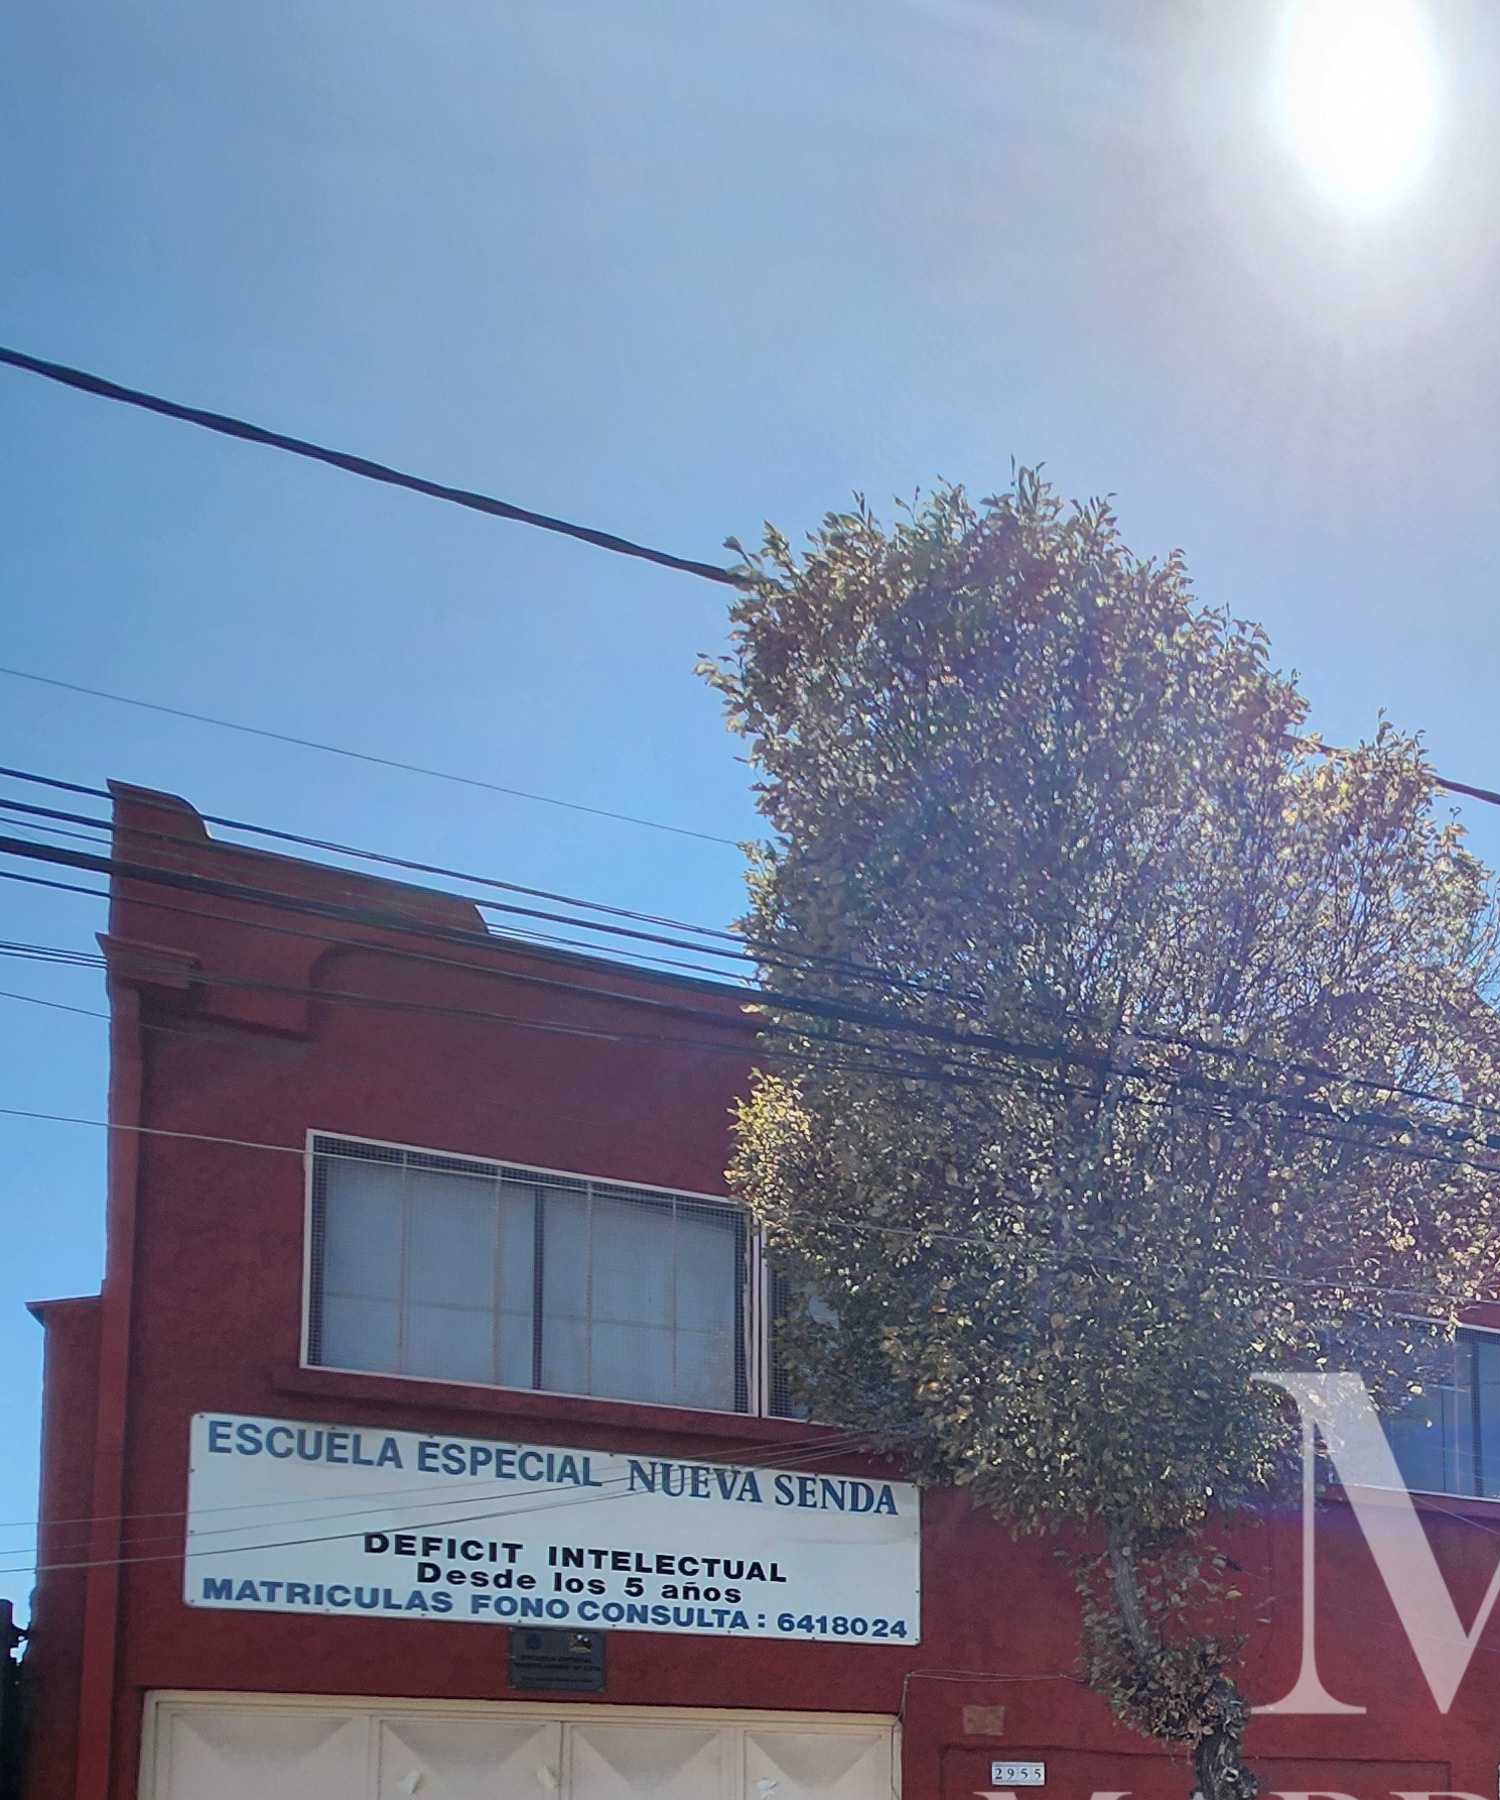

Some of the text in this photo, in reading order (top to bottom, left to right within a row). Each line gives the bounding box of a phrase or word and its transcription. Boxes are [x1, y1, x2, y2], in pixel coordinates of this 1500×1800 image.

[207, 1419, 899, 1517] ESCUELA ESPECIAL NUEVA SENDA
[363, 1532, 788, 1584] DEFICIT INTELECTUAL
[416, 1561, 743, 1605] Desde los 5 años
[202, 1577, 454, 1614] MATRICULAS
[469, 1593, 571, 1620] FONO
[776, 1612, 909, 1640] 6418024
[995, 1768, 1042, 1780] 2955
